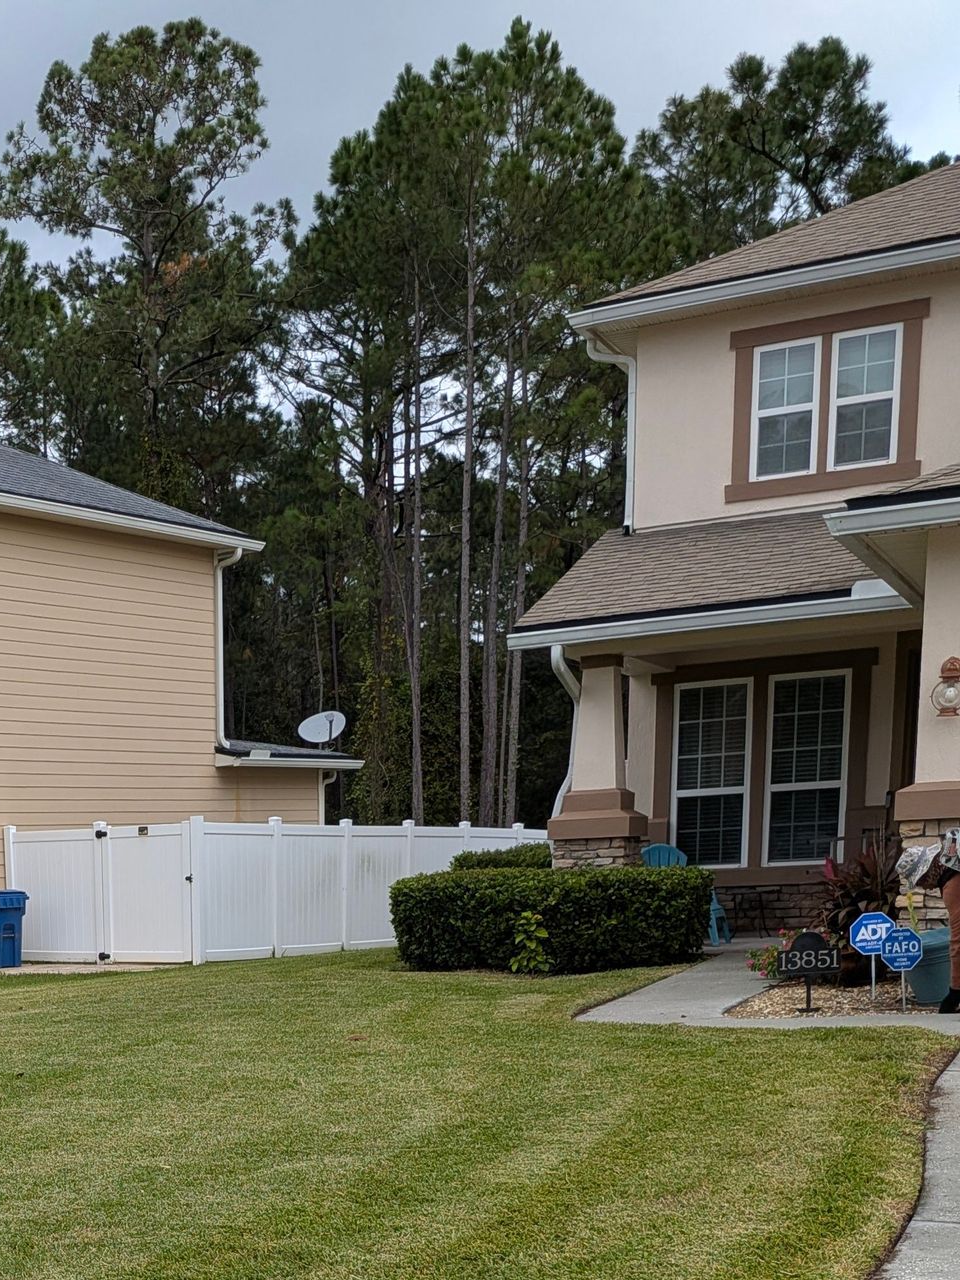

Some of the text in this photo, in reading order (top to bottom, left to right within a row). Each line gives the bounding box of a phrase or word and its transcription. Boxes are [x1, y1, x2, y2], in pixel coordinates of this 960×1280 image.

[855, 923, 891, 942] ADT
[885, 941, 919, 954] FAFO
[779, 949, 840, 971] 13851
